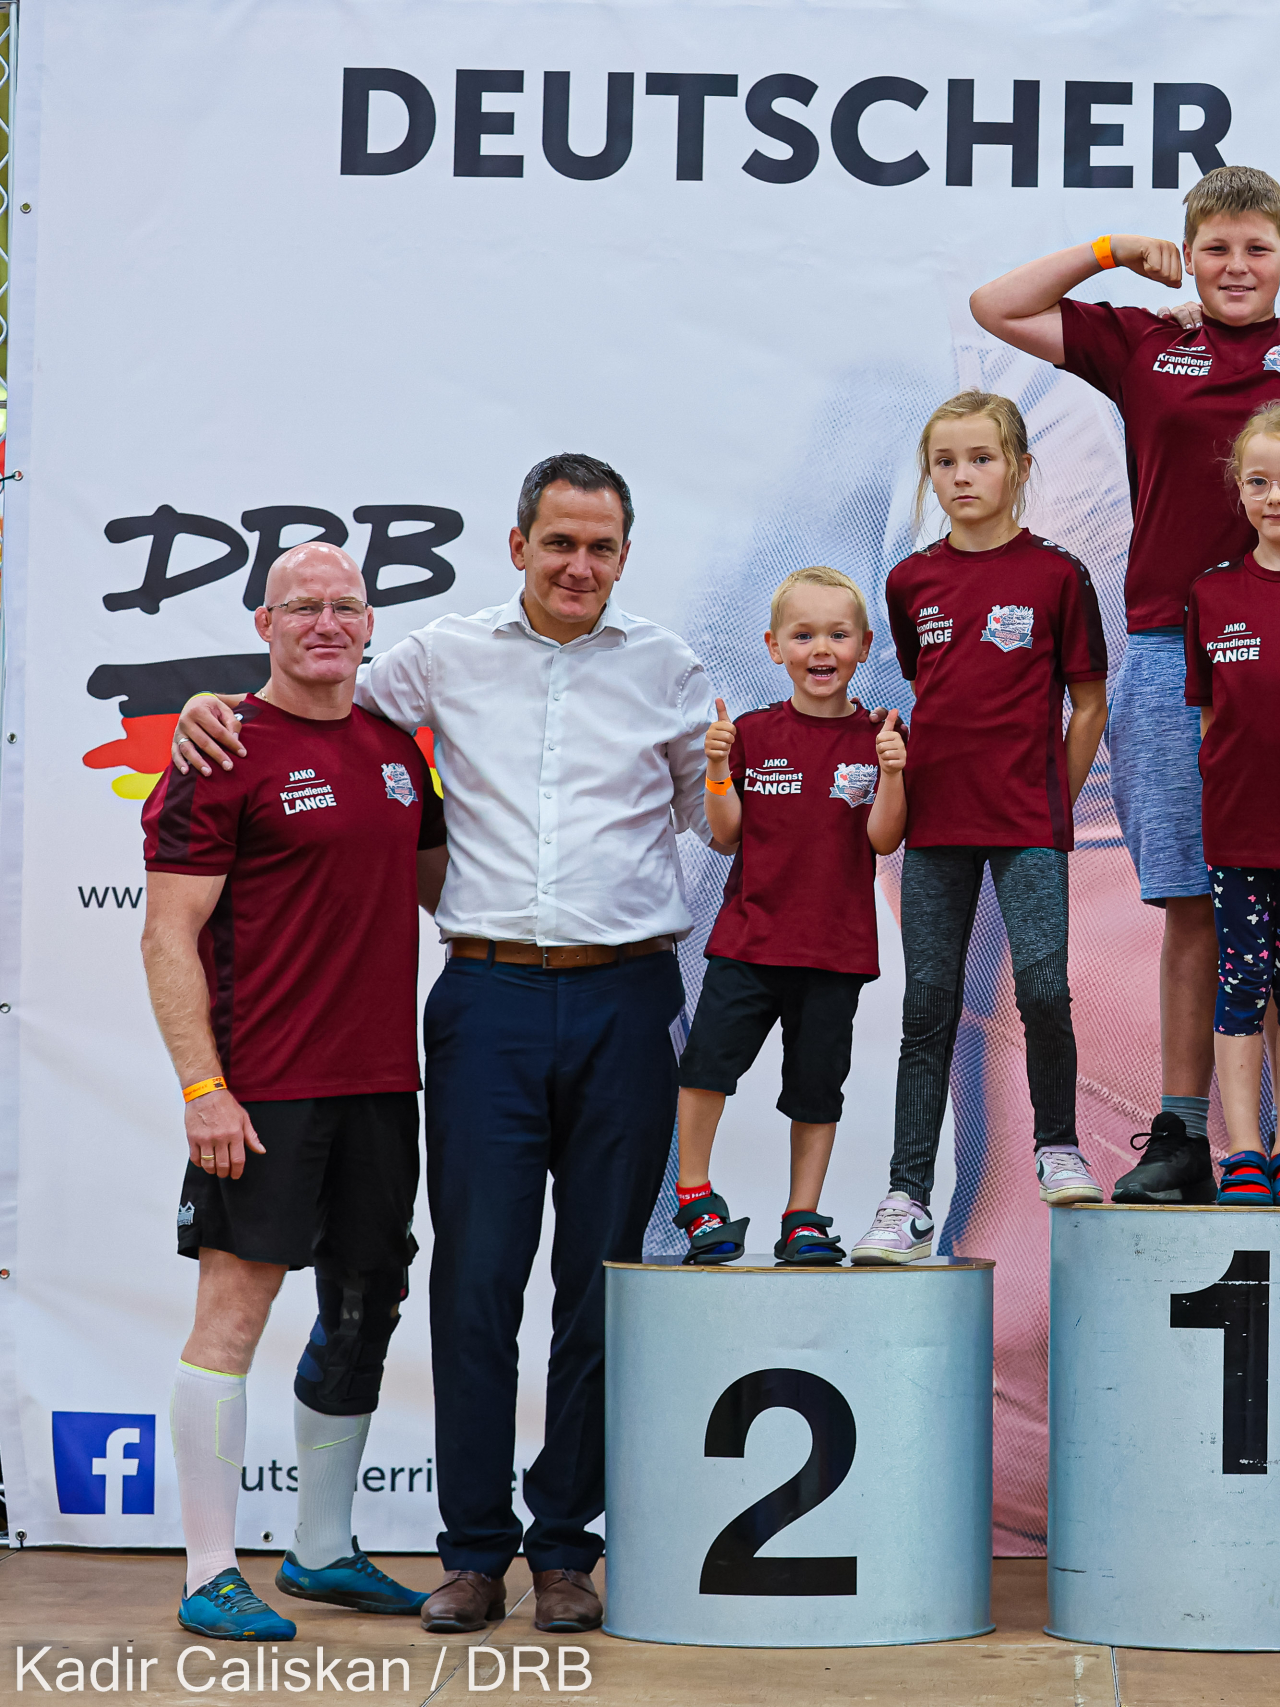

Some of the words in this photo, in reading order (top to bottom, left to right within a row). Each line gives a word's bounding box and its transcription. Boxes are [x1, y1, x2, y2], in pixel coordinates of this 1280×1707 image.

[341, 67, 1232, 189] DEUTSCHER
[1157, 353, 1213, 366] Krandienst
[1152, 361, 1211, 376] LANGE
[919, 605, 939, 617] JAKO
[1223, 622, 1246, 633] JAKO
[1206, 637, 1261, 651] Krandienst
[1208, 647, 1260, 663] ANGE
[763, 758, 788, 767] JAKO
[289, 769, 315, 781] JAKO
[745, 768, 803, 781] Krandienst
[280, 785, 332, 801] Krandienst
[744, 779, 802, 795] LANGE
[283, 794, 337, 815] LANGE
[1169, 1250, 1271, 1475] 1
[699, 1367, 858, 1597] 2
